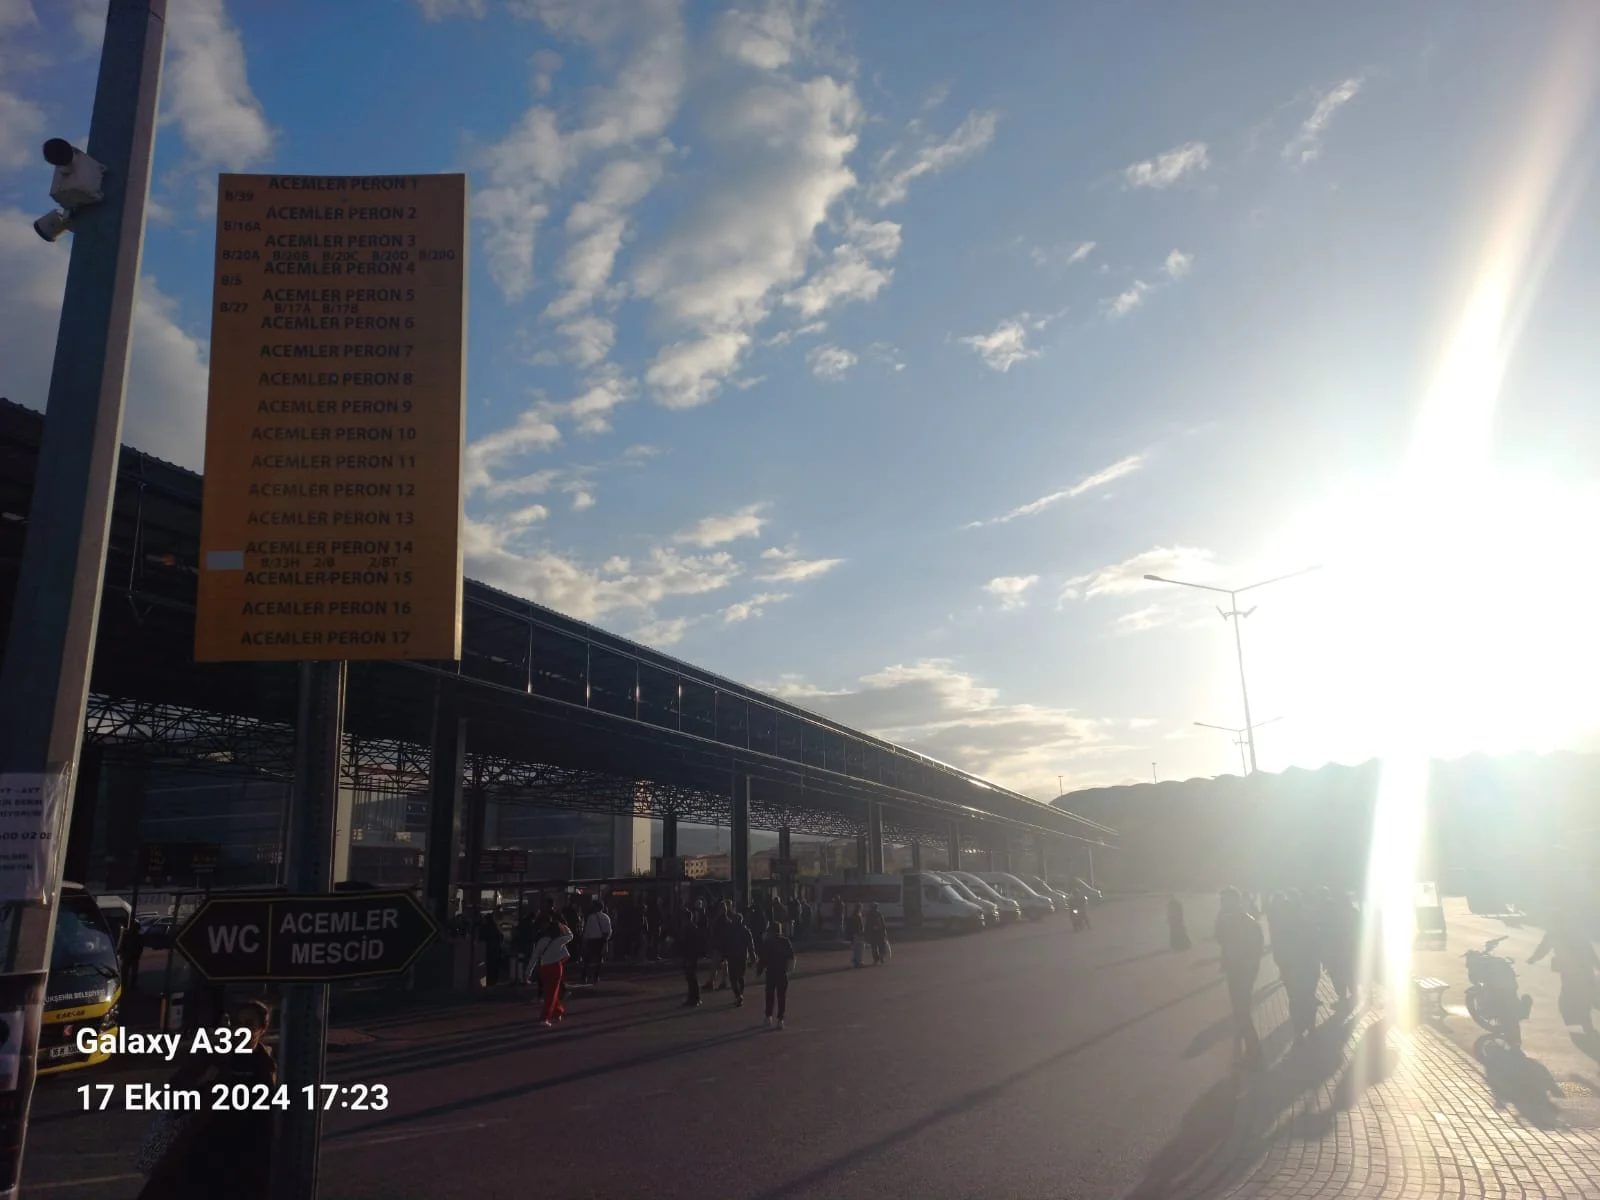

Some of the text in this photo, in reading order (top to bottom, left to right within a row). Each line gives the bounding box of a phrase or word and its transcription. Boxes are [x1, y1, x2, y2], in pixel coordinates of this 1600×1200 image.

[269, 177, 418, 190] ACEMLER PERON 1
[266, 207, 417, 220] ACEMLER PERON 2
[265, 234, 416, 247] ACEMLER PERON 3
[264, 262, 415, 275] ACEMLER PERON 4
[262, 289, 414, 302] ACEMLER PERON 5
[274, 303, 311, 314] B/17A
[322, 303, 358, 314] B/17B
[261, 316, 414, 329] ACEMLER PERON 6
[260, 344, 413, 358] ACEMLER PERON 7
[259, 372, 413, 386] ACEMLER PERON 8
[257, 400, 412, 414] ACEMLER PERON 9
[251, 427, 416, 441] ACEMLER PERON 10
[251, 455, 415, 468] ACEMLER PERON 11
[249, 483, 415, 497] ACEMLER PERON 12
[247, 512, 414, 525] ACEMLER PERON 13
[245, 541, 413, 555] ACEMLER PERON 14
[244, 571, 412, 585] ACEMLER PERON 15
[242, 601, 411, 615] ACEMLER PERON 16
[241, 631, 410, 645] ACEMLER PERON 17
[280, 908, 398, 934] ACEMLER
[208, 925, 260, 954] WC
[292, 935, 384, 964] MESCİD
